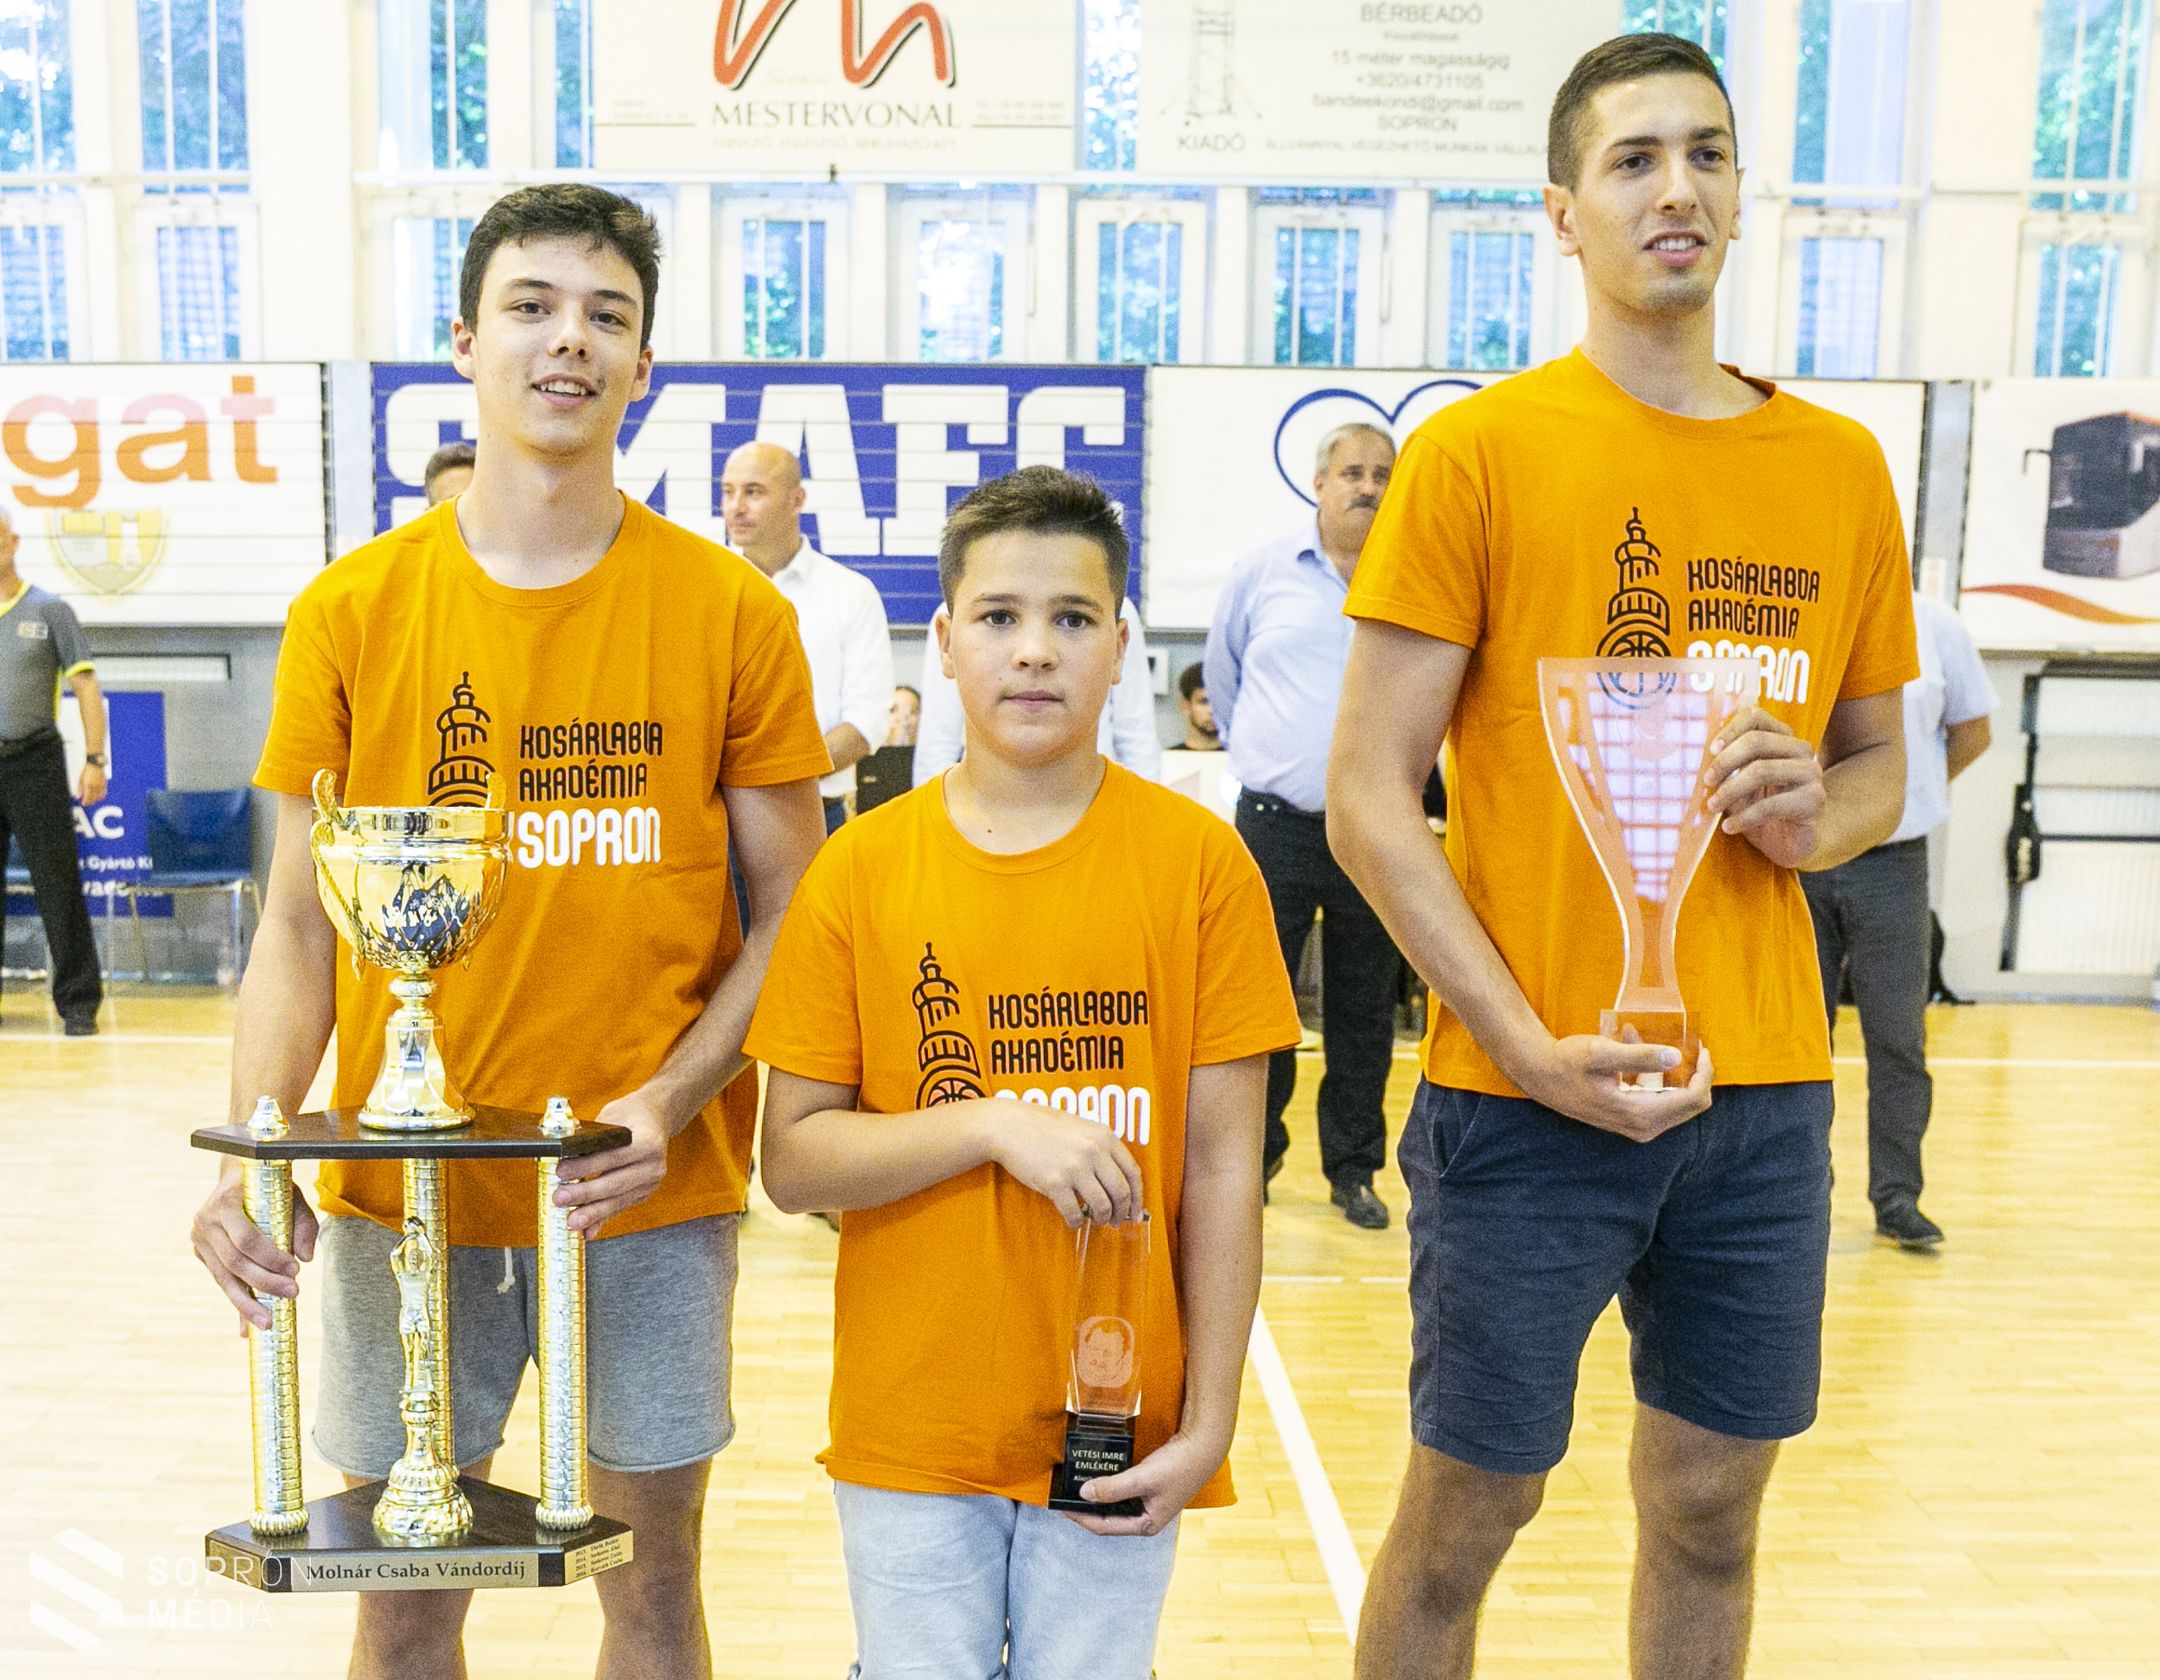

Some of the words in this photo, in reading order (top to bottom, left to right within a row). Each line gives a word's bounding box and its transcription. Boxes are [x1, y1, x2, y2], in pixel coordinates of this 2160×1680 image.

[1360, 2, 1483, 24] BÉRBEADÓ
[1333, 49, 1350, 65] 15
[712, 102, 962, 128] MESTERVONAL
[1377, 115, 1458, 132] SOPRON
[1177, 133, 1246, 152] KIADÓ
[2, 376, 279, 508] gat
[1687, 556, 1820, 603] KOSÁRLABDA
[1688, 597, 1800, 640] AKADÉMIA
[519, 758, 648, 802] AKADÉMIA
[517, 806, 662, 869] SOPRON
[988, 985, 1149, 1030] KOSÁRLABDA
[991, 1030, 1125, 1075] AKADÉMIA
[1072, 1449, 1101, 1459] VETÉSI
[1102, 1451, 1124, 1461] IMRE
[1075, 1460, 1119, 1472] EMLÉKÉRE
[307, 1562, 372, 1580] Molnár
[377, 1563, 430, 1579] Csaba
[436, 1560, 526, 1580] Vándordíj
